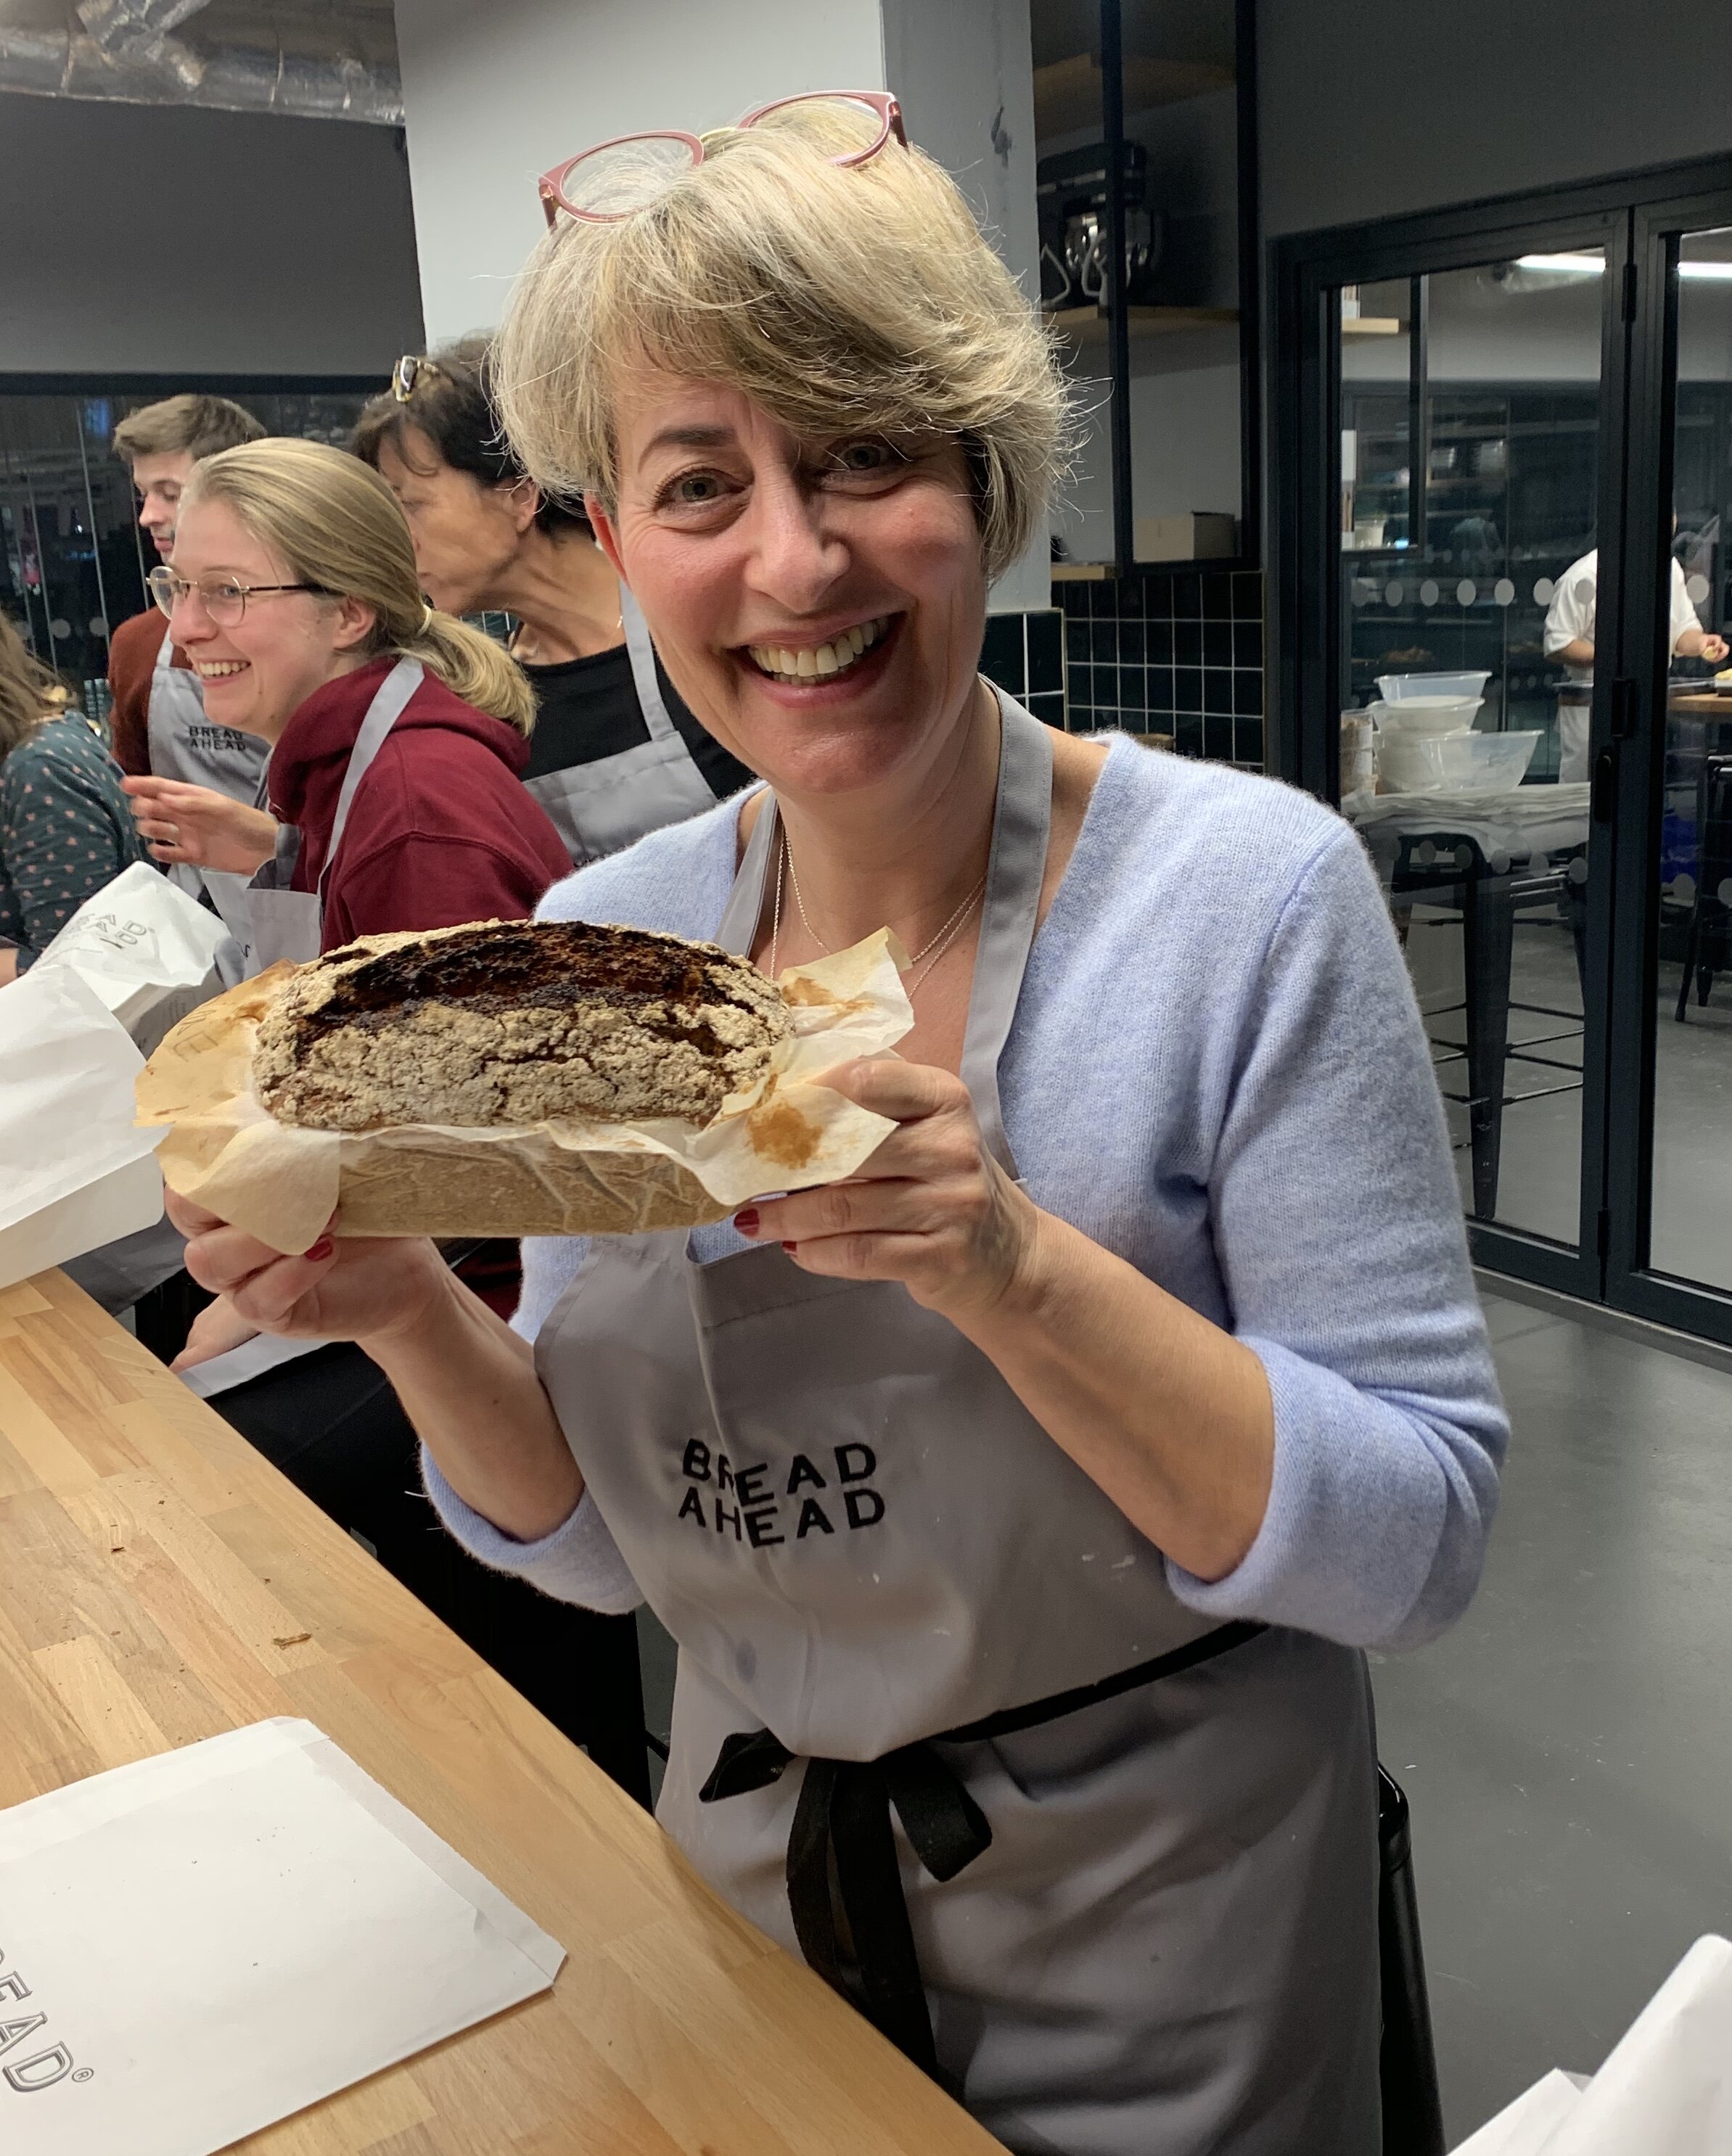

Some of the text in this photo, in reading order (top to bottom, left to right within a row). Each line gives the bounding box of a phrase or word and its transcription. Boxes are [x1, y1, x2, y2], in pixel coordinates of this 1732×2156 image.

[189, 726, 242, 740] BREAD
[191, 738, 245, 751] AHEAD
[683, 1439, 877, 1506] BREAD
[678, 1487, 885, 1549] AHEAD
